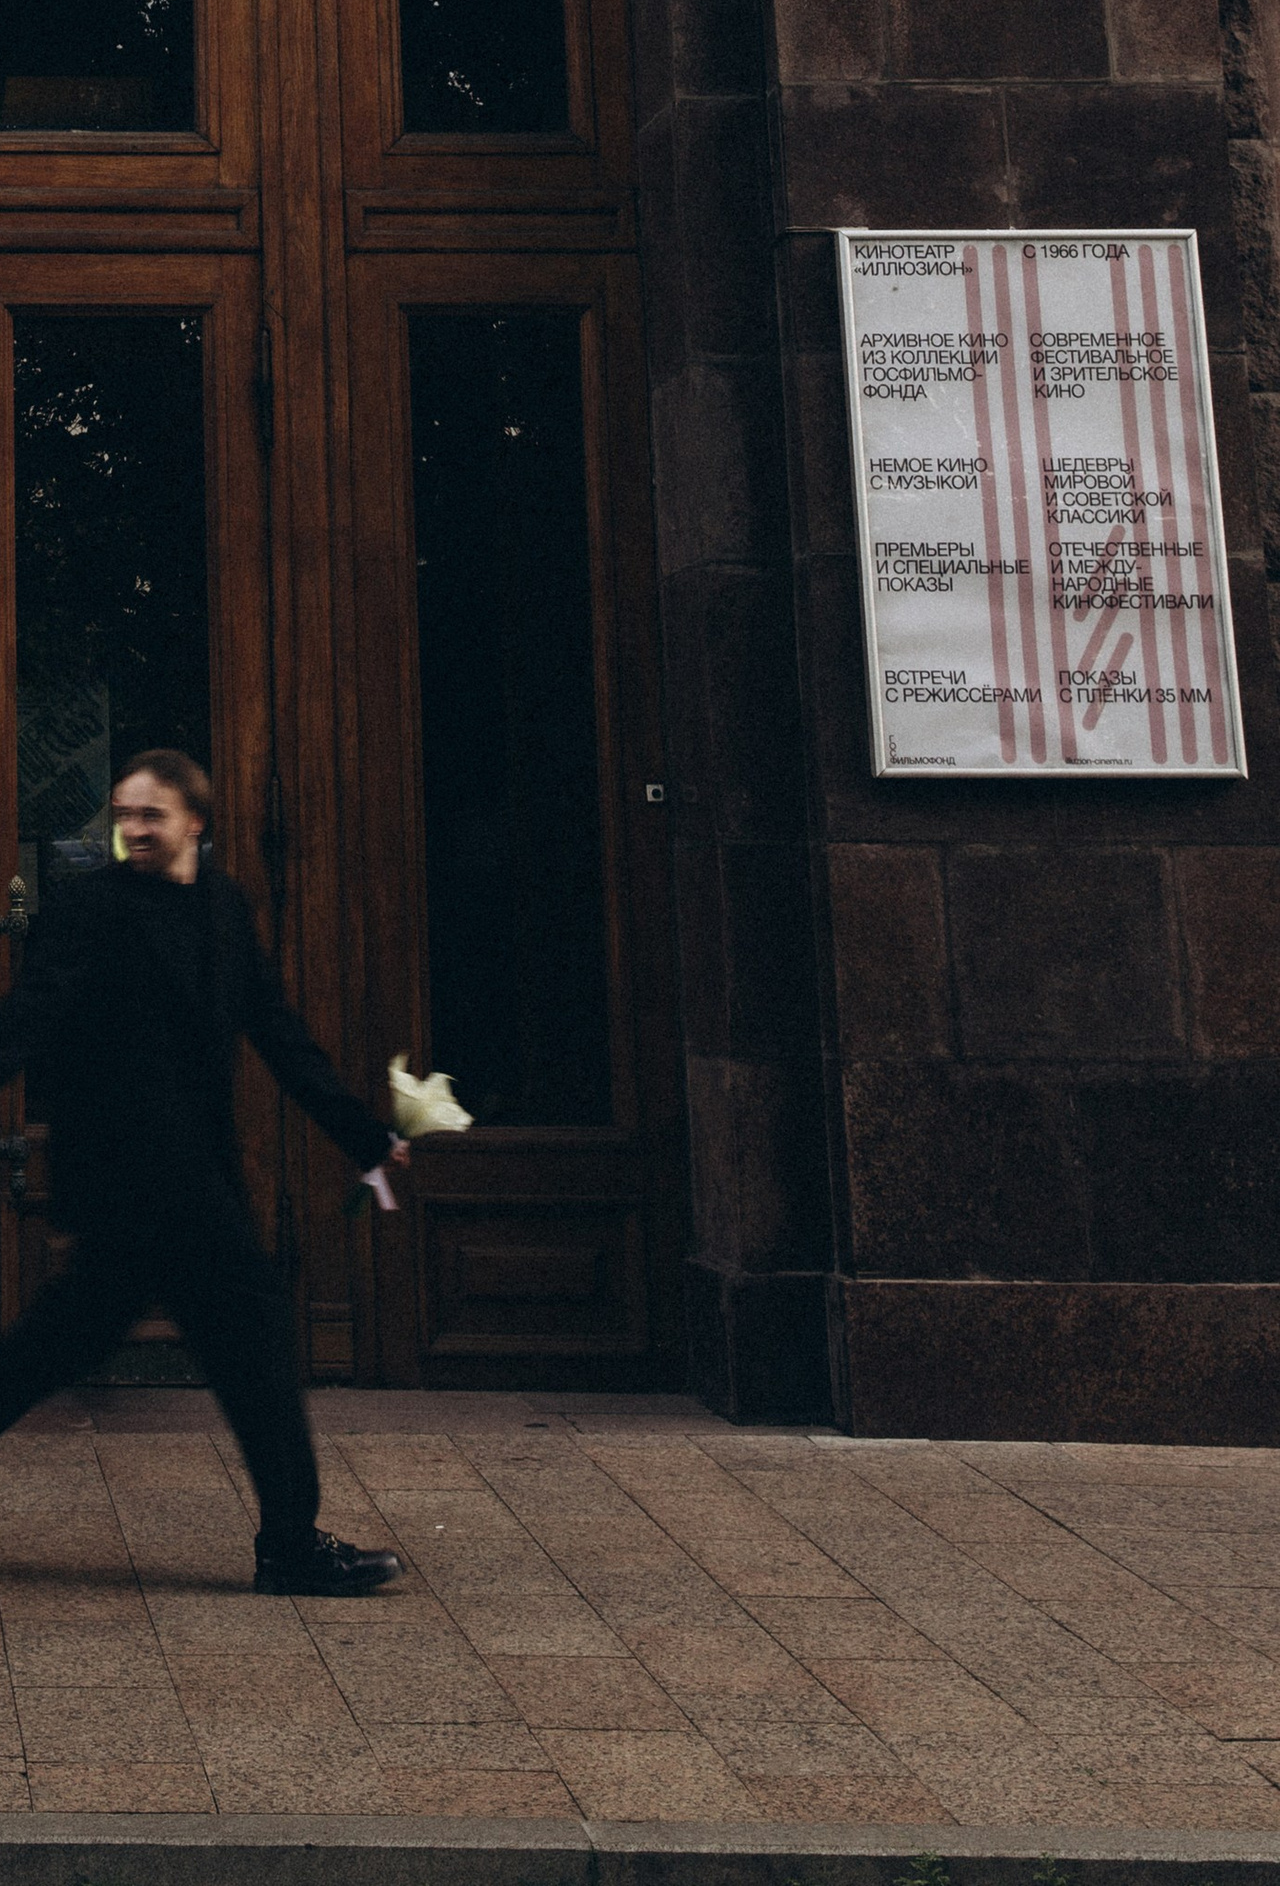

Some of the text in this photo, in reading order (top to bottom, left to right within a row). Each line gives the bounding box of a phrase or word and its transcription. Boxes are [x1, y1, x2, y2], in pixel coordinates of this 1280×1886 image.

[854, 244, 955, 259] КИНОТЕАТР
[1023, 243, 1130, 261] С 1966 ГОДА
[853, 261, 973, 276] «ИЛЛЮЗИОН»
[860, 333, 1009, 348] АРХИВНОЕ КИНО
[1030, 332, 1166, 348] СОВРЕМЕННОЕ
[862, 350, 999, 367] ИЗ КОЛЛЕКЦИИ
[1030, 349, 1174, 364] ФЕСТИВАЛЬНОЕ
[863, 367, 983, 382] ГОСФИЛЬМО-
[1033, 366, 1178, 382] И ЗРИТЕЛЬСКОЕ
[863, 384, 928, 401] ФОНДА
[1034, 383, 1085, 399] КИНО
[870, 457, 988, 473] НЕМОЕ КИНО
[1042, 458, 1134, 474] ШЕДЕВРЫ
[870, 471, 978, 490] С МУЗЫКОЙ
[1044, 470, 1135, 489] МИРОВОЙ
[1045, 488, 1173, 507] И СОВЕТСКОЙ
[1047, 509, 1145, 524] КЛАССИКИ
[875, 542, 975, 557] ПРЕМЬЕРЫ
[1048, 541, 1204, 557] ОТЕЧЕСТВЕННЫЕ
[876, 559, 1030, 577] И СПЕЦИАЛЬНЫЕ
[1051, 559, 1142, 577] И МЕЖДУ-
[878, 577, 954, 592] ПОКАЗЫ
[1052, 577, 1154, 594] НАРОДНЫЕ
[1053, 594, 1214, 610] КИНОФЕСТИВАЛИ
[885, 670, 967, 685] ВСТРЕЧИ
[1059, 670, 1137, 685] ПОКАЗЫ
[885, 684, 1043, 703] С РЕЖИССЁРАМИ
[1059, 684, 1212, 703] С ПЛЁНКИ 35 ММ
[890, 756, 956, 766] ФИЛЬМОФОНД
